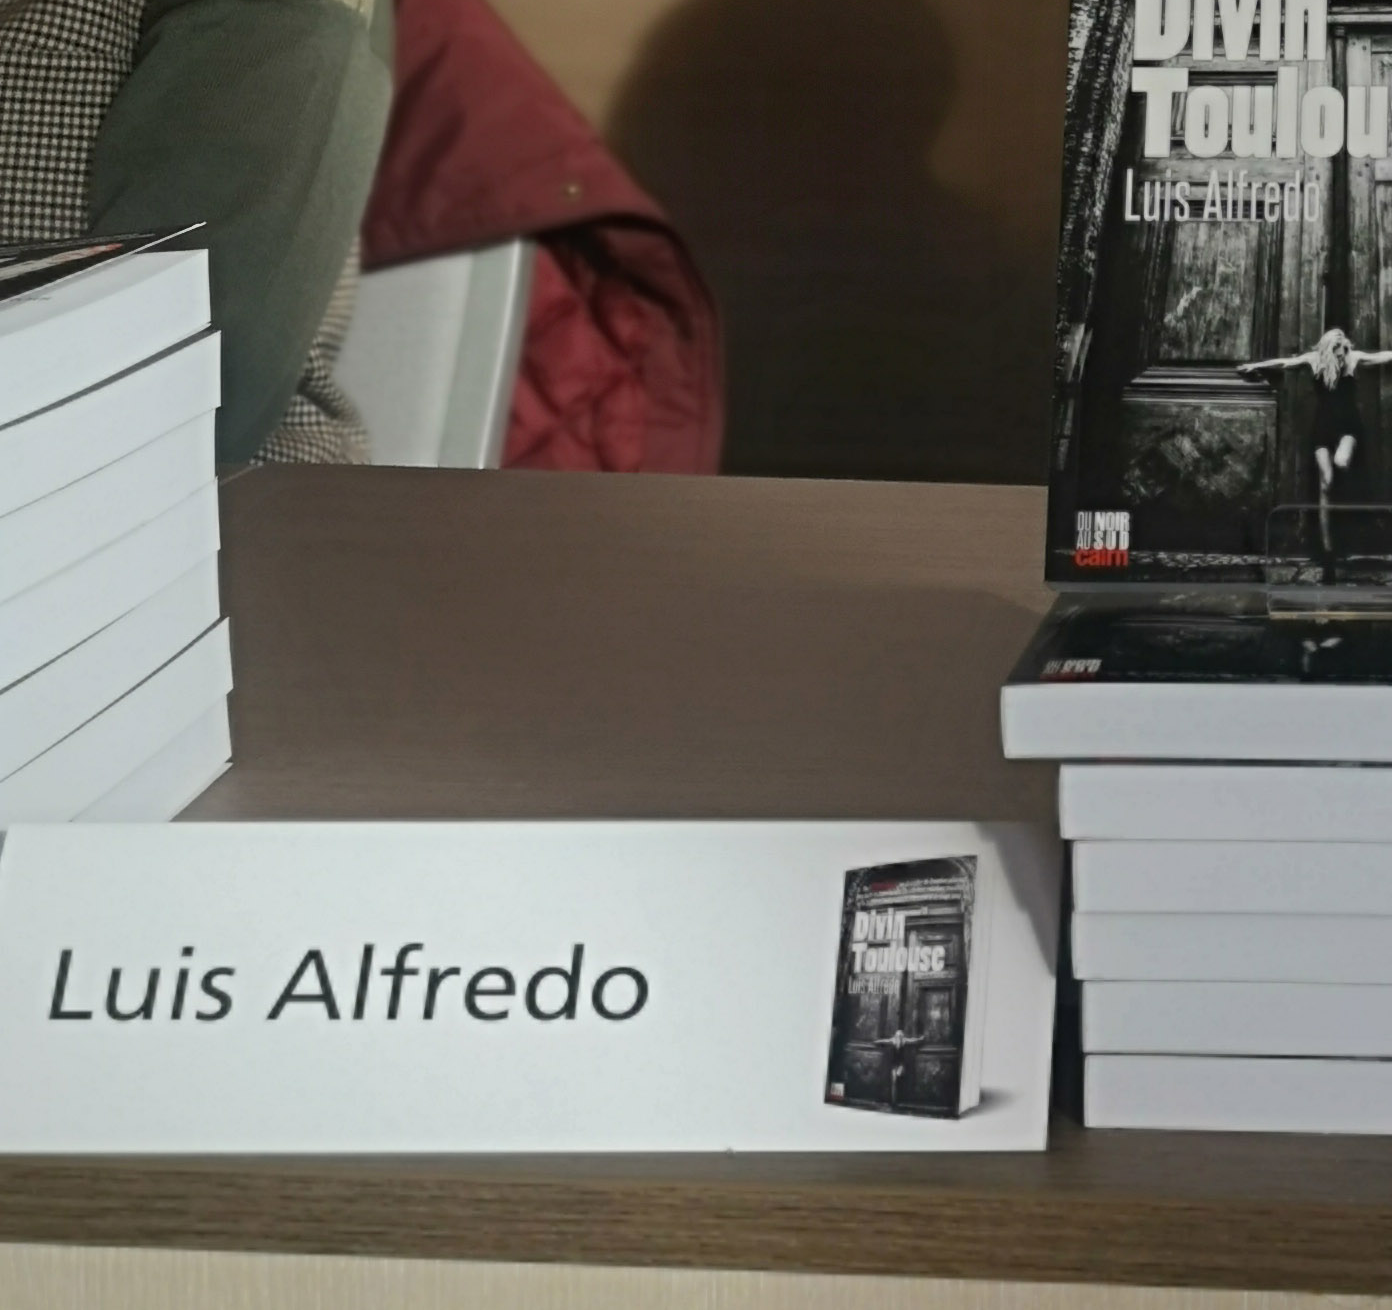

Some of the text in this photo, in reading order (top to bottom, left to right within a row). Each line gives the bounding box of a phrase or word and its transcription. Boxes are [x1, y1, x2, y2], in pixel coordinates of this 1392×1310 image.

[1125, 169, 1321, 222] Luis Alfredo
[1078, 511, 1130, 531] DU NOIR
[1076, 530, 1129, 550] AU SUD
[854, 907, 907, 941] Divin
[852, 941, 946, 973] Toulouse
[48, 942, 650, 1021] Luis Alfredo
